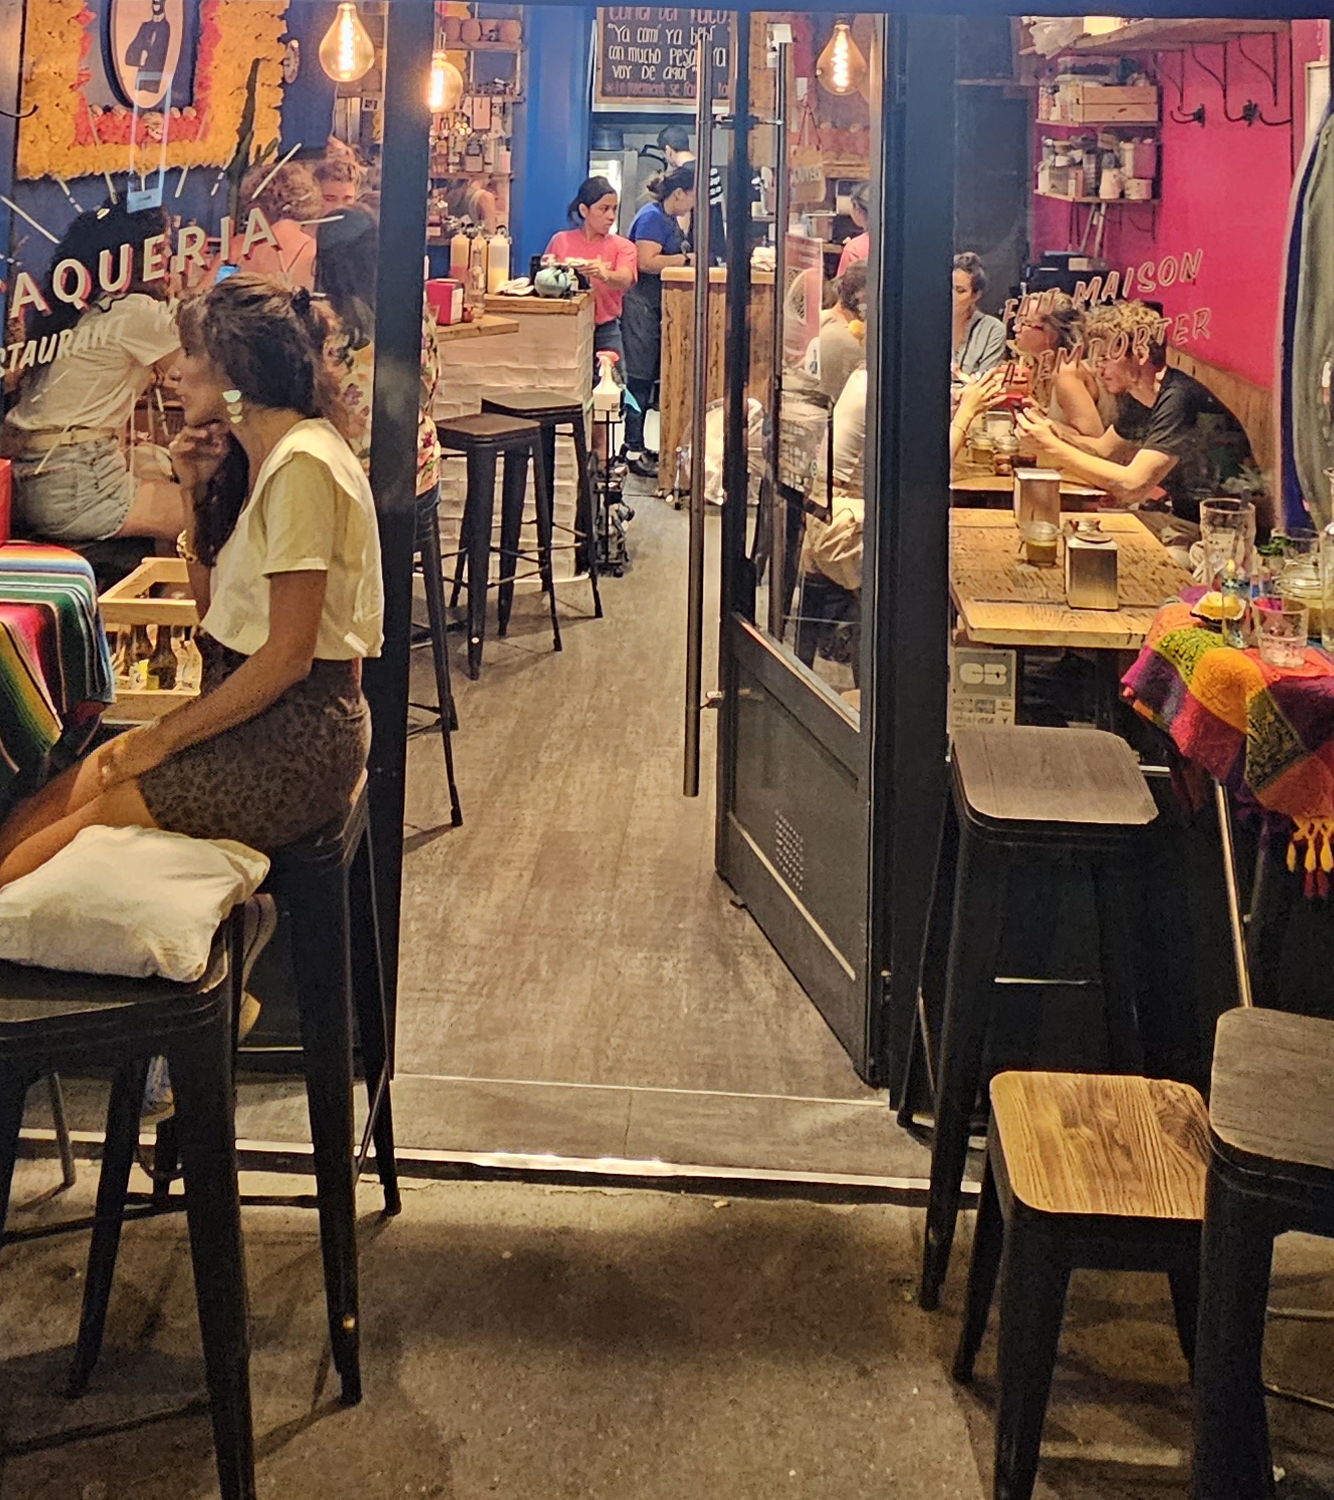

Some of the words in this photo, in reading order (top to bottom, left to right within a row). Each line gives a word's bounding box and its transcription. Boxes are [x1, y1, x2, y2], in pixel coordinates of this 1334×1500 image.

[669, 48, 698, 67] Pesa
[1002, 287, 1061, 325] FAIT
[1071, 248, 1204, 307] MAISON
[1035, 307, 1213, 382] EMPORTER
